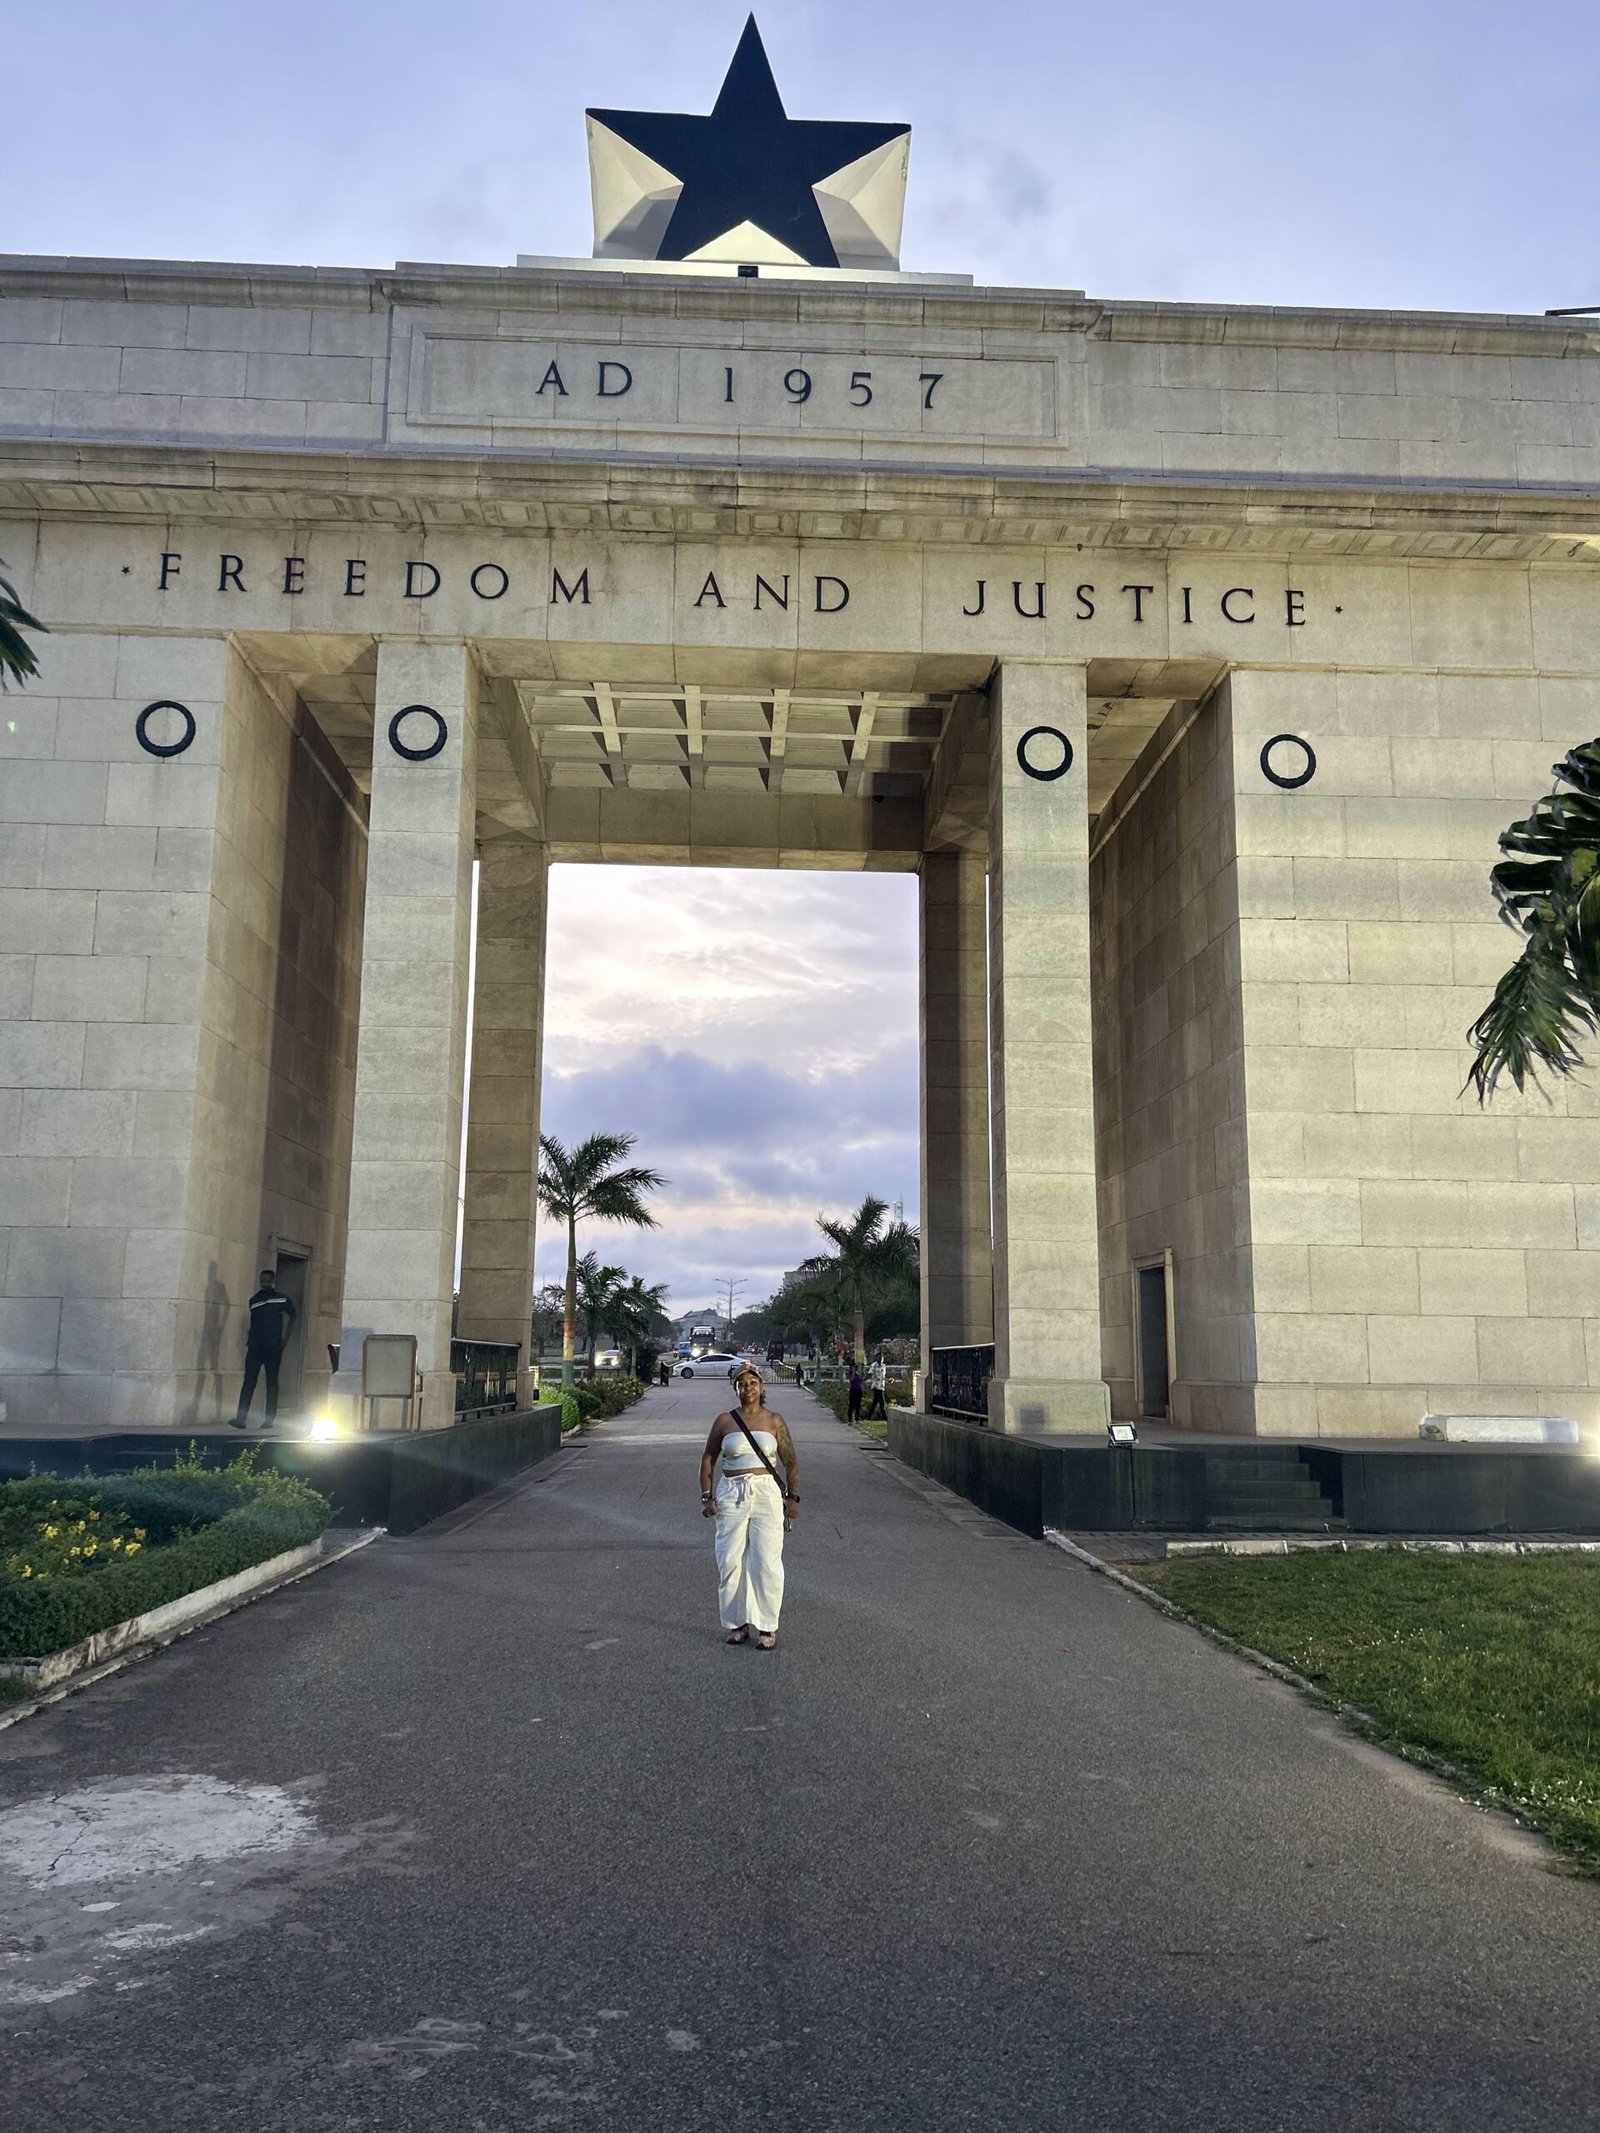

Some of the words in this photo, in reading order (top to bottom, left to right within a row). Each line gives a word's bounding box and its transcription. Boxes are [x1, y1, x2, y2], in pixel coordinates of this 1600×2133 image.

[535, 359, 633, 397] AD
[724, 367, 944, 409] 1957
[157, 552, 591, 604] FREEDOM
[693, 571, 850, 613] AND
[963, 580, 1306, 627] JUSTICE
